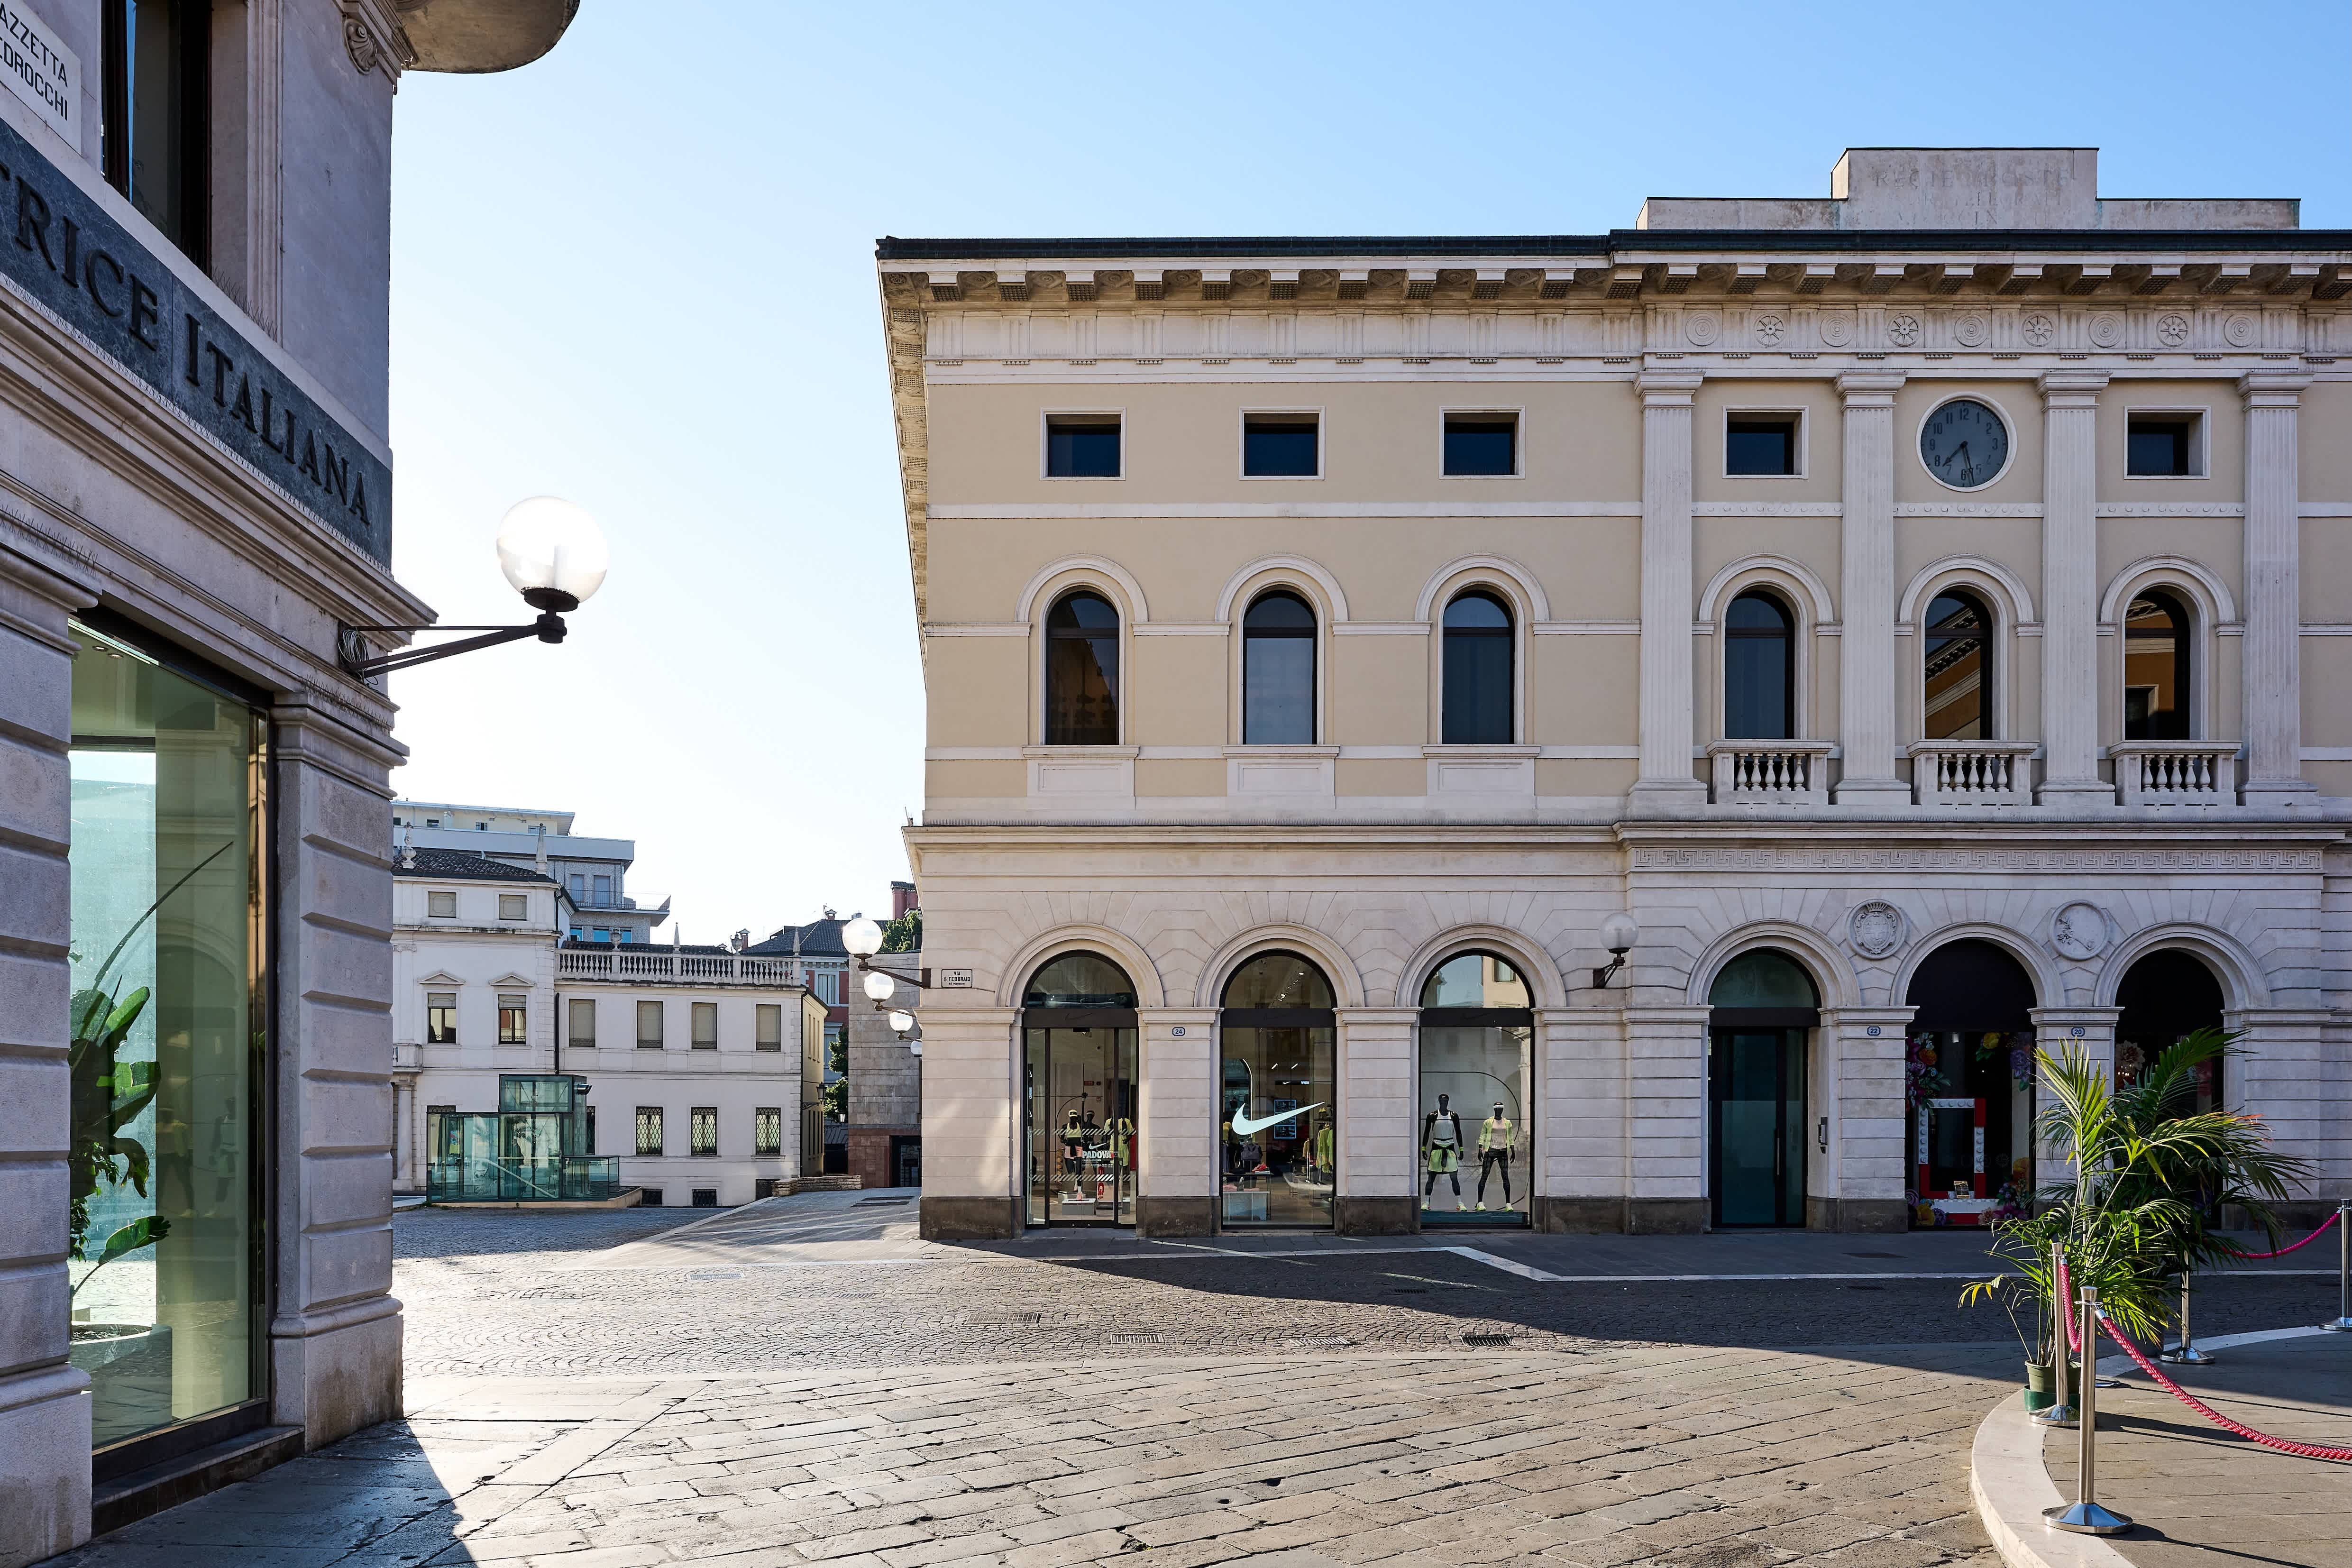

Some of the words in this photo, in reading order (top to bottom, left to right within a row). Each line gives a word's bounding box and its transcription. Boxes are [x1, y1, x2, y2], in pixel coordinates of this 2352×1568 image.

[0, 3, 67, 88] AZZETTA
[0, 36, 67, 121] DROCCHI
[0, 163, 158, 351] RICE
[185, 313, 370, 526] ITALIANA
[1946, 412, 1953, 424] 11
[1959, 408, 1969, 421] 12
[1976, 412, 1980, 423] 1
[1933, 422, 1942, 434] 10
[1986, 422, 1992, 434] 2
[1930, 439, 1935, 450] 9
[1992, 438, 1998, 450] 3
[1934, 455, 1940, 467] 8
[1961, 469, 1966, 480] 6
[1976, 464, 1981, 475] 5
[1082, 1151, 1111, 1159] PADOVA
